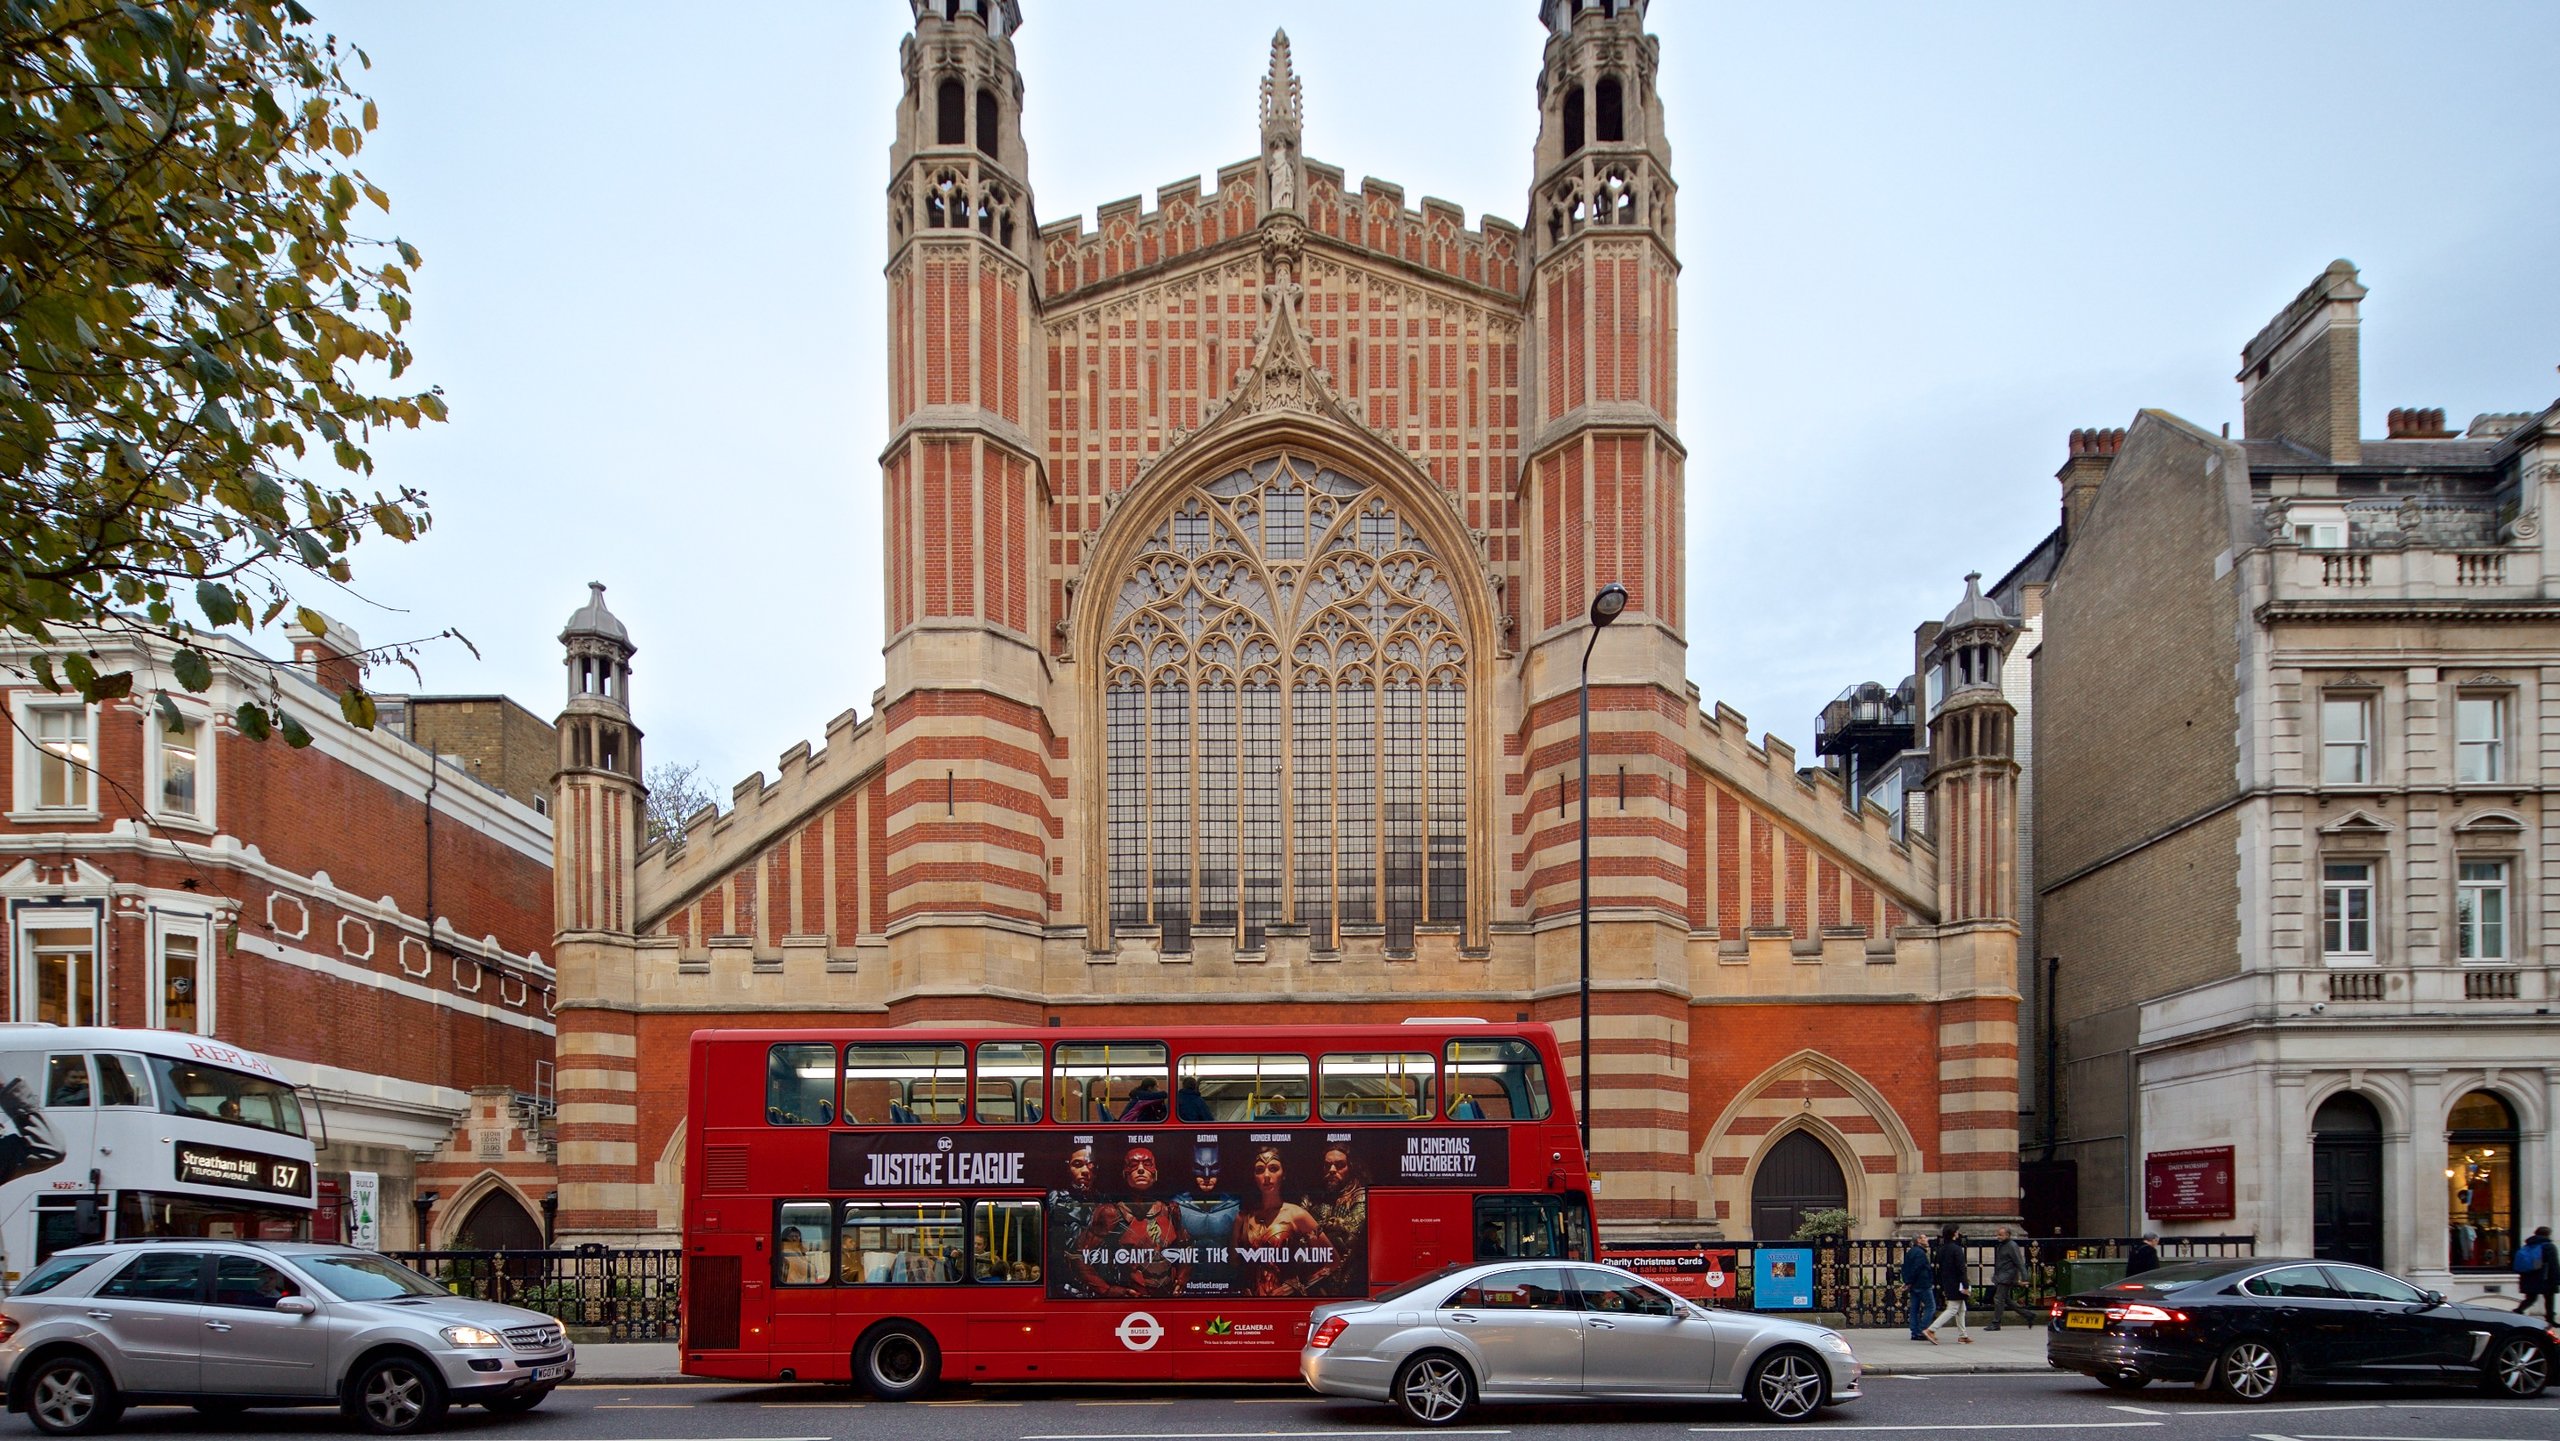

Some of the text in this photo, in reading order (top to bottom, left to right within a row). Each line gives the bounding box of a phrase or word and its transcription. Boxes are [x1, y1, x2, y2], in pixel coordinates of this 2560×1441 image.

[186, 1042, 272, 1075] REPLAY
[1073, 1135, 1094, 1144] CYBORG
[1127, 1134, 1154, 1143] THE FLASH
[1196, 1134, 1218, 1142] BATMAN
[1250, 1133, 1292, 1142] WONDER WOMAN
[1326, 1133, 1352, 1142] AQUAMAN
[1407, 1137, 1470, 1154] IN CINEMAS
[183, 1151, 257, 1174] Streatham Hill
[1401, 1155, 1477, 1172] NOVEMBER 17
[864, 1152, 1025, 1185] JUSTICE LEAGUE
[191, 1166, 249, 1182] TELFORD AVENUE
[272, 1165, 299, 1189] 137
[355, 1180, 375, 1189] BUILD
[1082, 1247, 1334, 1265] YOU CAN'T SAVE THE WORLD ALONE
[1602, 1257, 1703, 1267] Charity Christmas Cards
[1671, 1275, 1694, 1283] Saturday
[1186, 1281, 1229, 1290] #JusticeLeague
